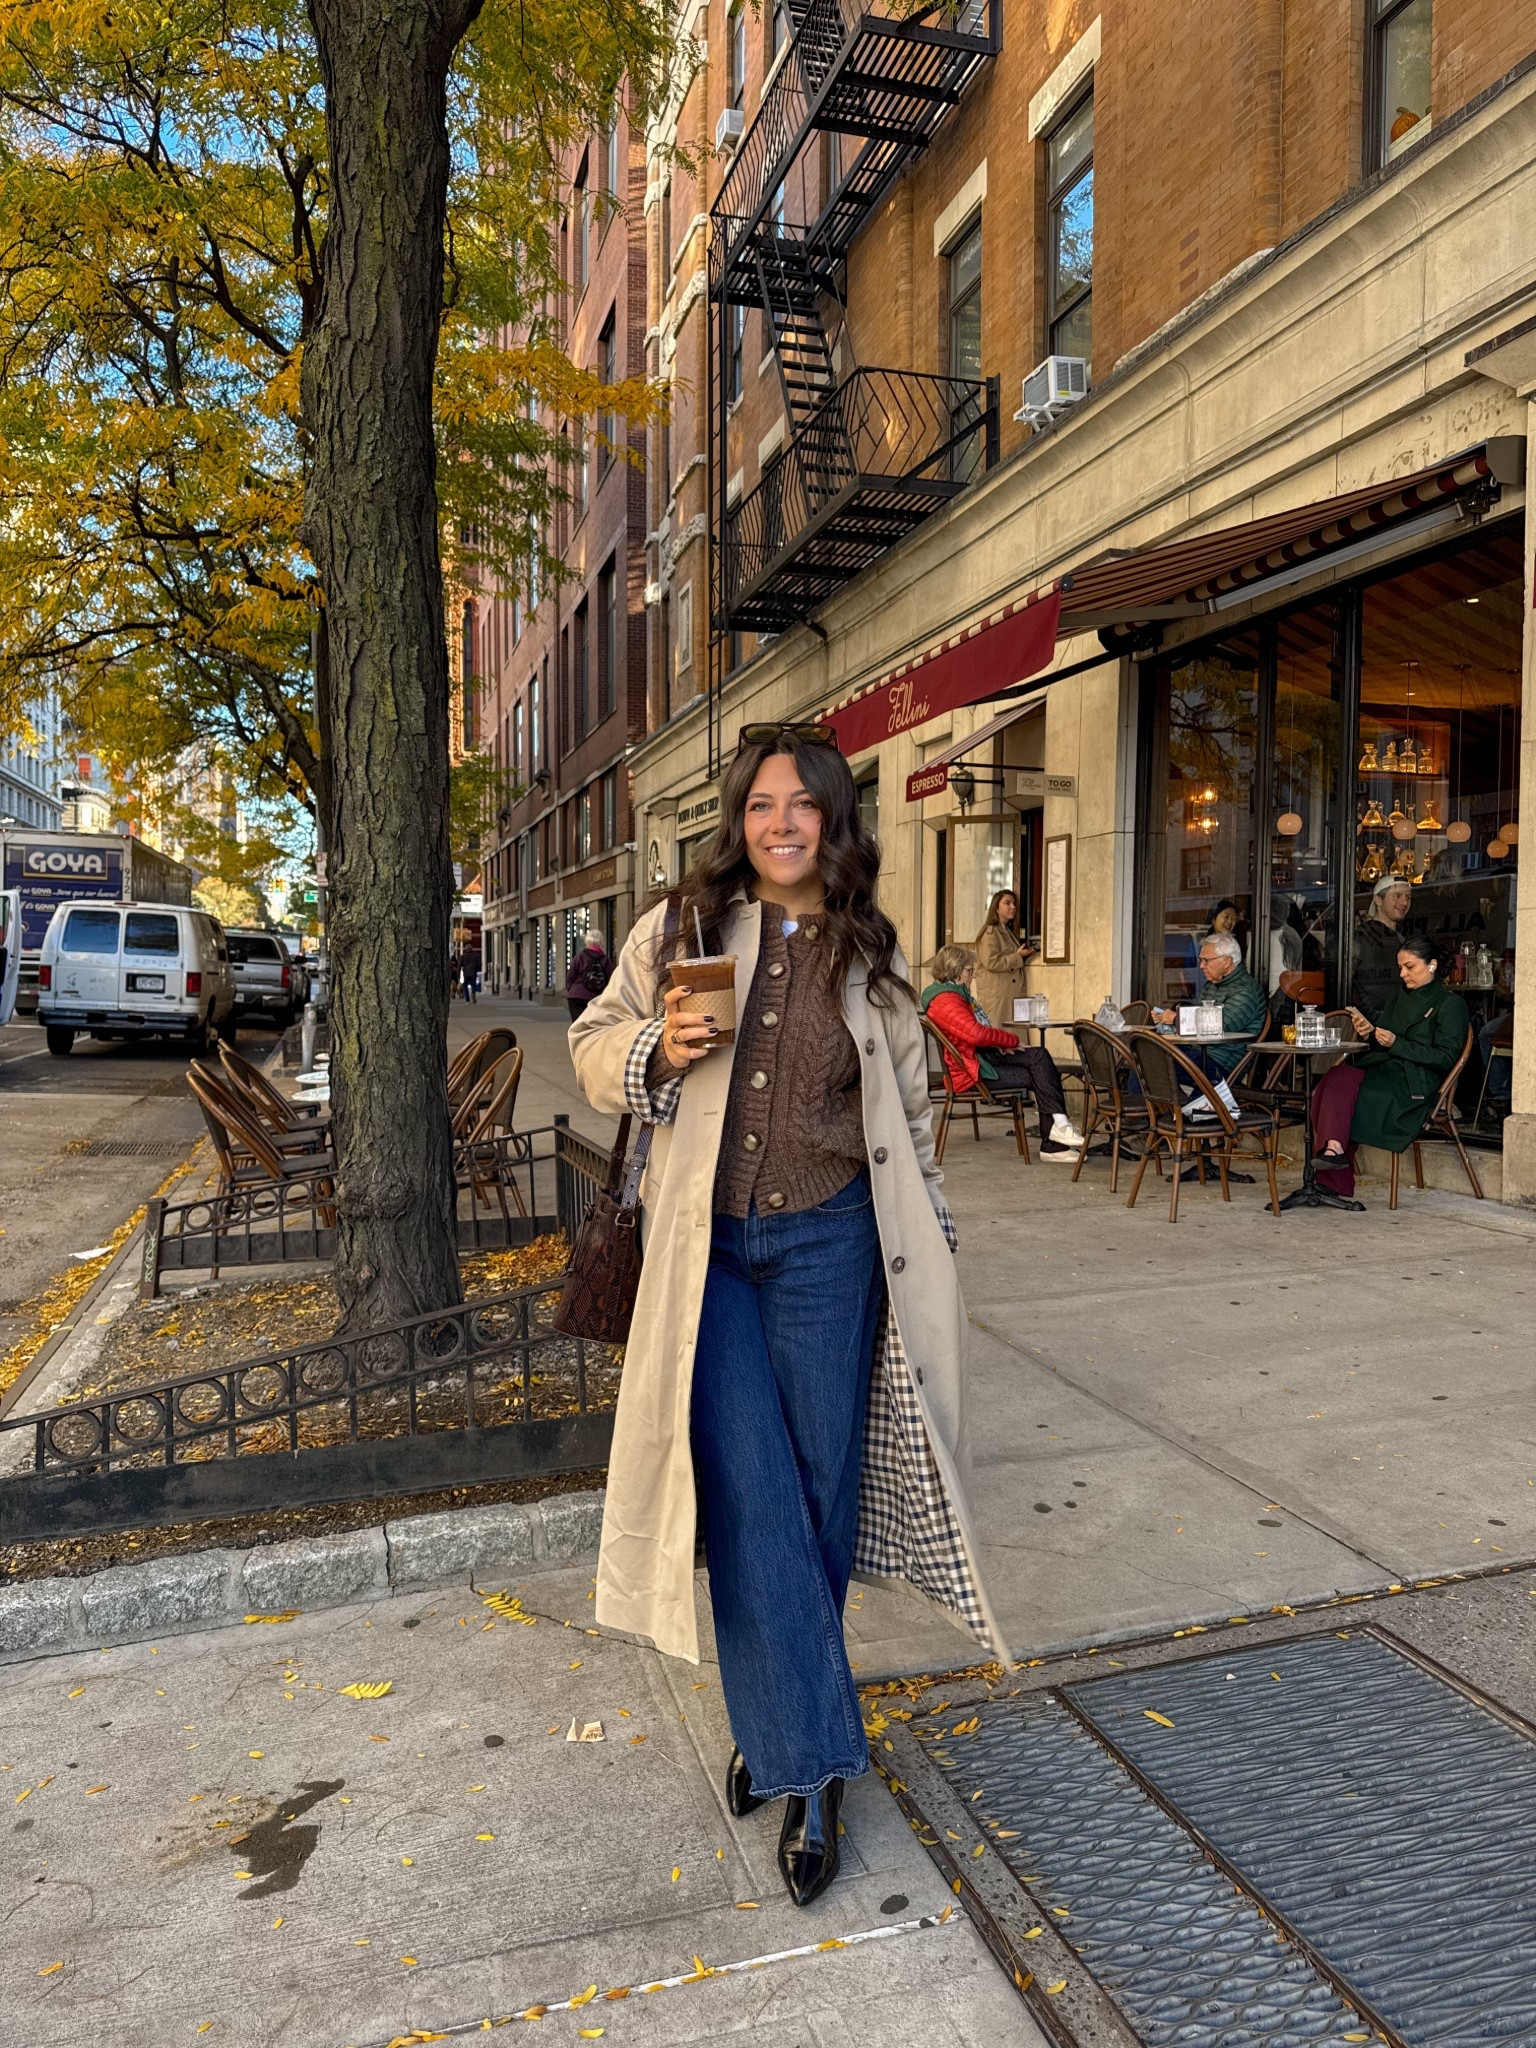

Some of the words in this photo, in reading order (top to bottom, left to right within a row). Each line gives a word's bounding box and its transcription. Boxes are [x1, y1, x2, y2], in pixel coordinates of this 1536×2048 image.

[888, 681, 930, 733] Fellini
[911, 772, 944, 795] ESPRESSO
[1048, 779, 1059, 787] TO
[1060, 780, 1072, 788] GO
[28, 851, 102, 874] GOYA
